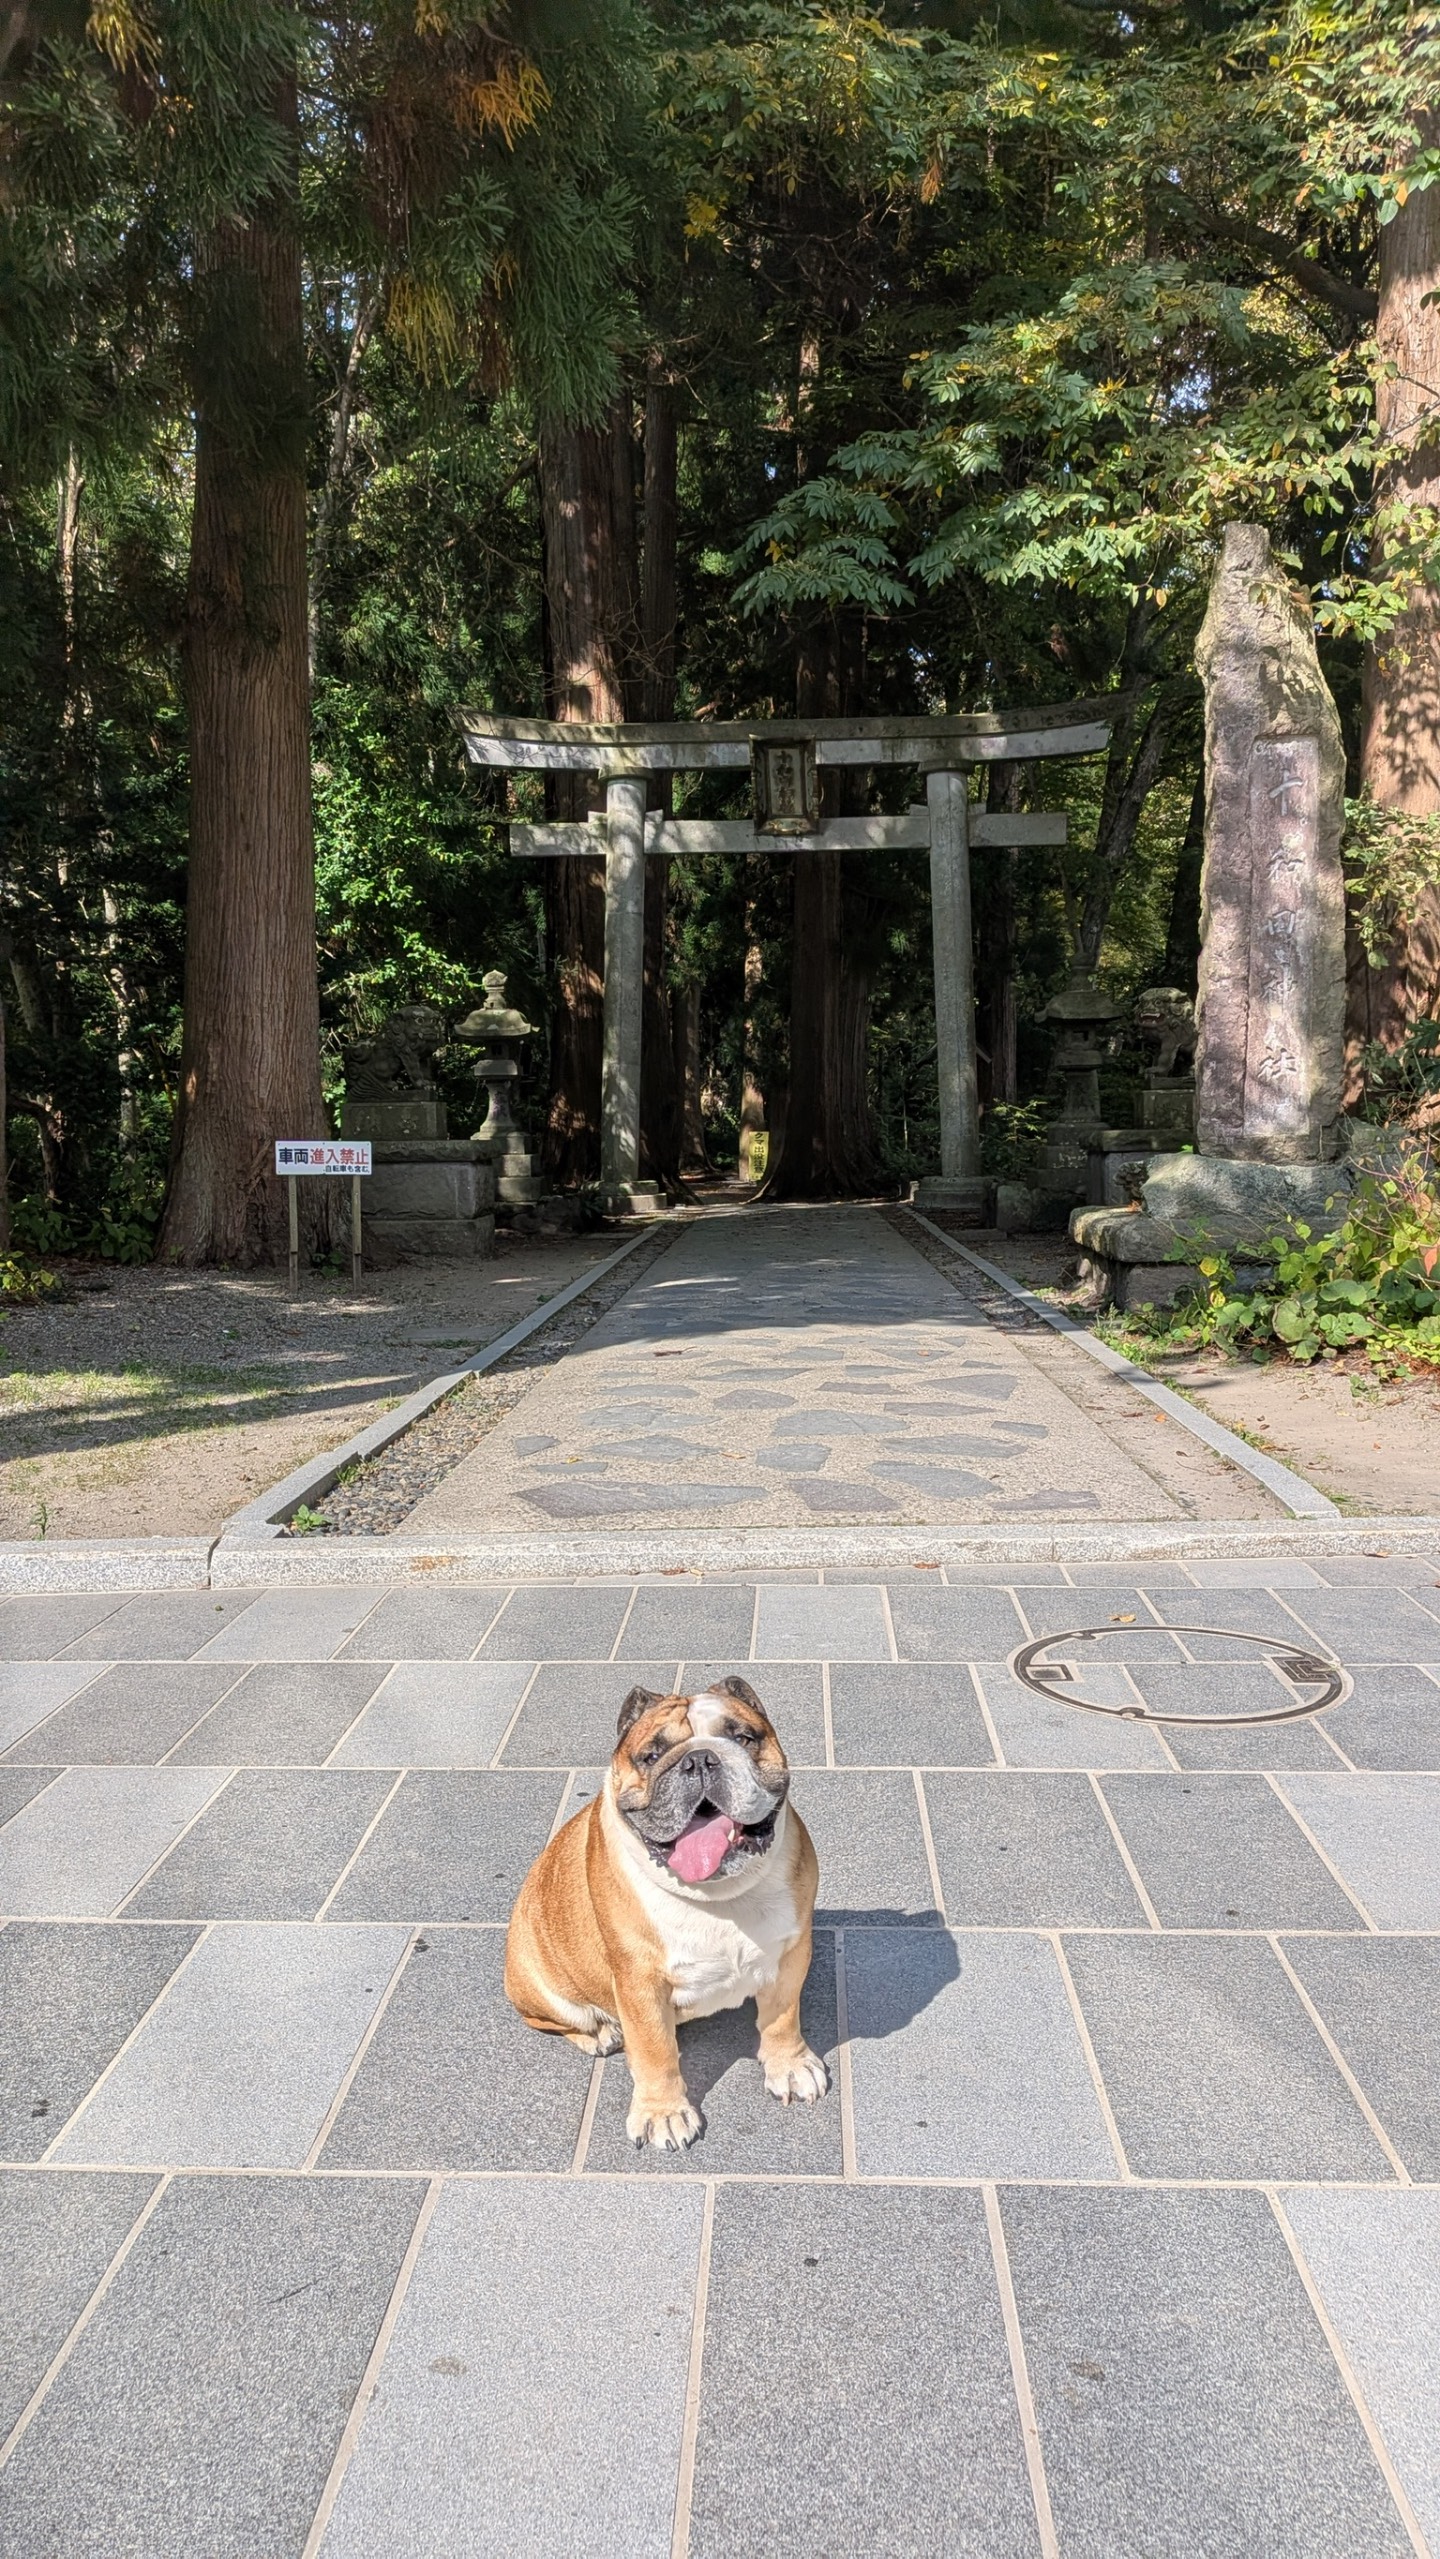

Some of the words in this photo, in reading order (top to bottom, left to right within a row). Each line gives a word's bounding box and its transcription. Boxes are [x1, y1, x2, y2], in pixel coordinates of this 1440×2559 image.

[278, 1147, 369, 1165] 車両進入禁止
